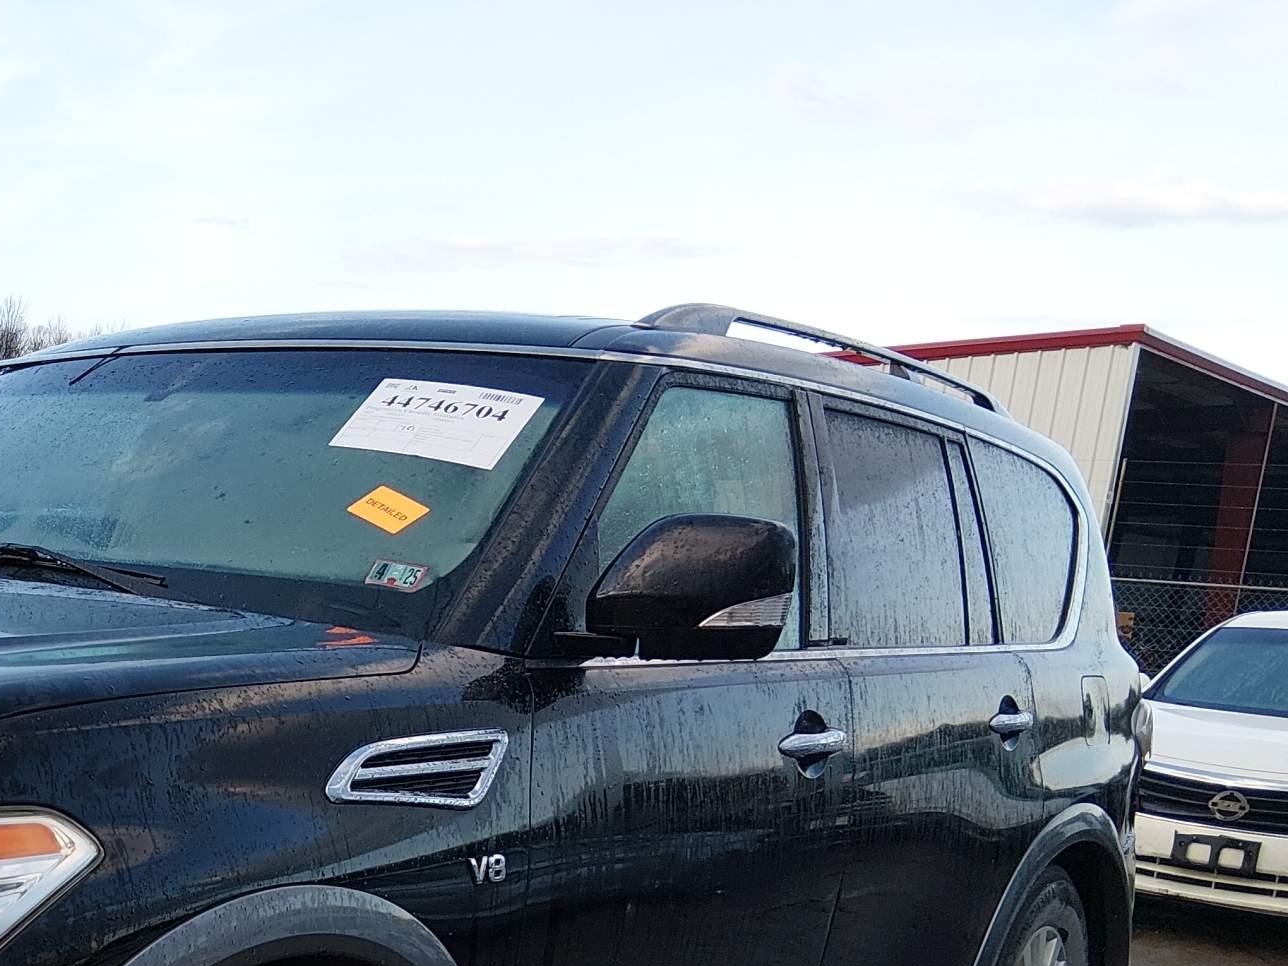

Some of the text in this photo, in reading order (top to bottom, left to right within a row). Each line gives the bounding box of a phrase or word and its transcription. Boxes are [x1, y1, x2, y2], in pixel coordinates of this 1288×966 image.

[380, 394, 511, 422] 44746704
[364, 497, 408, 522] DETAILED
[374, 563, 421, 586] 4 25
[468, 853, 506, 885] V8
